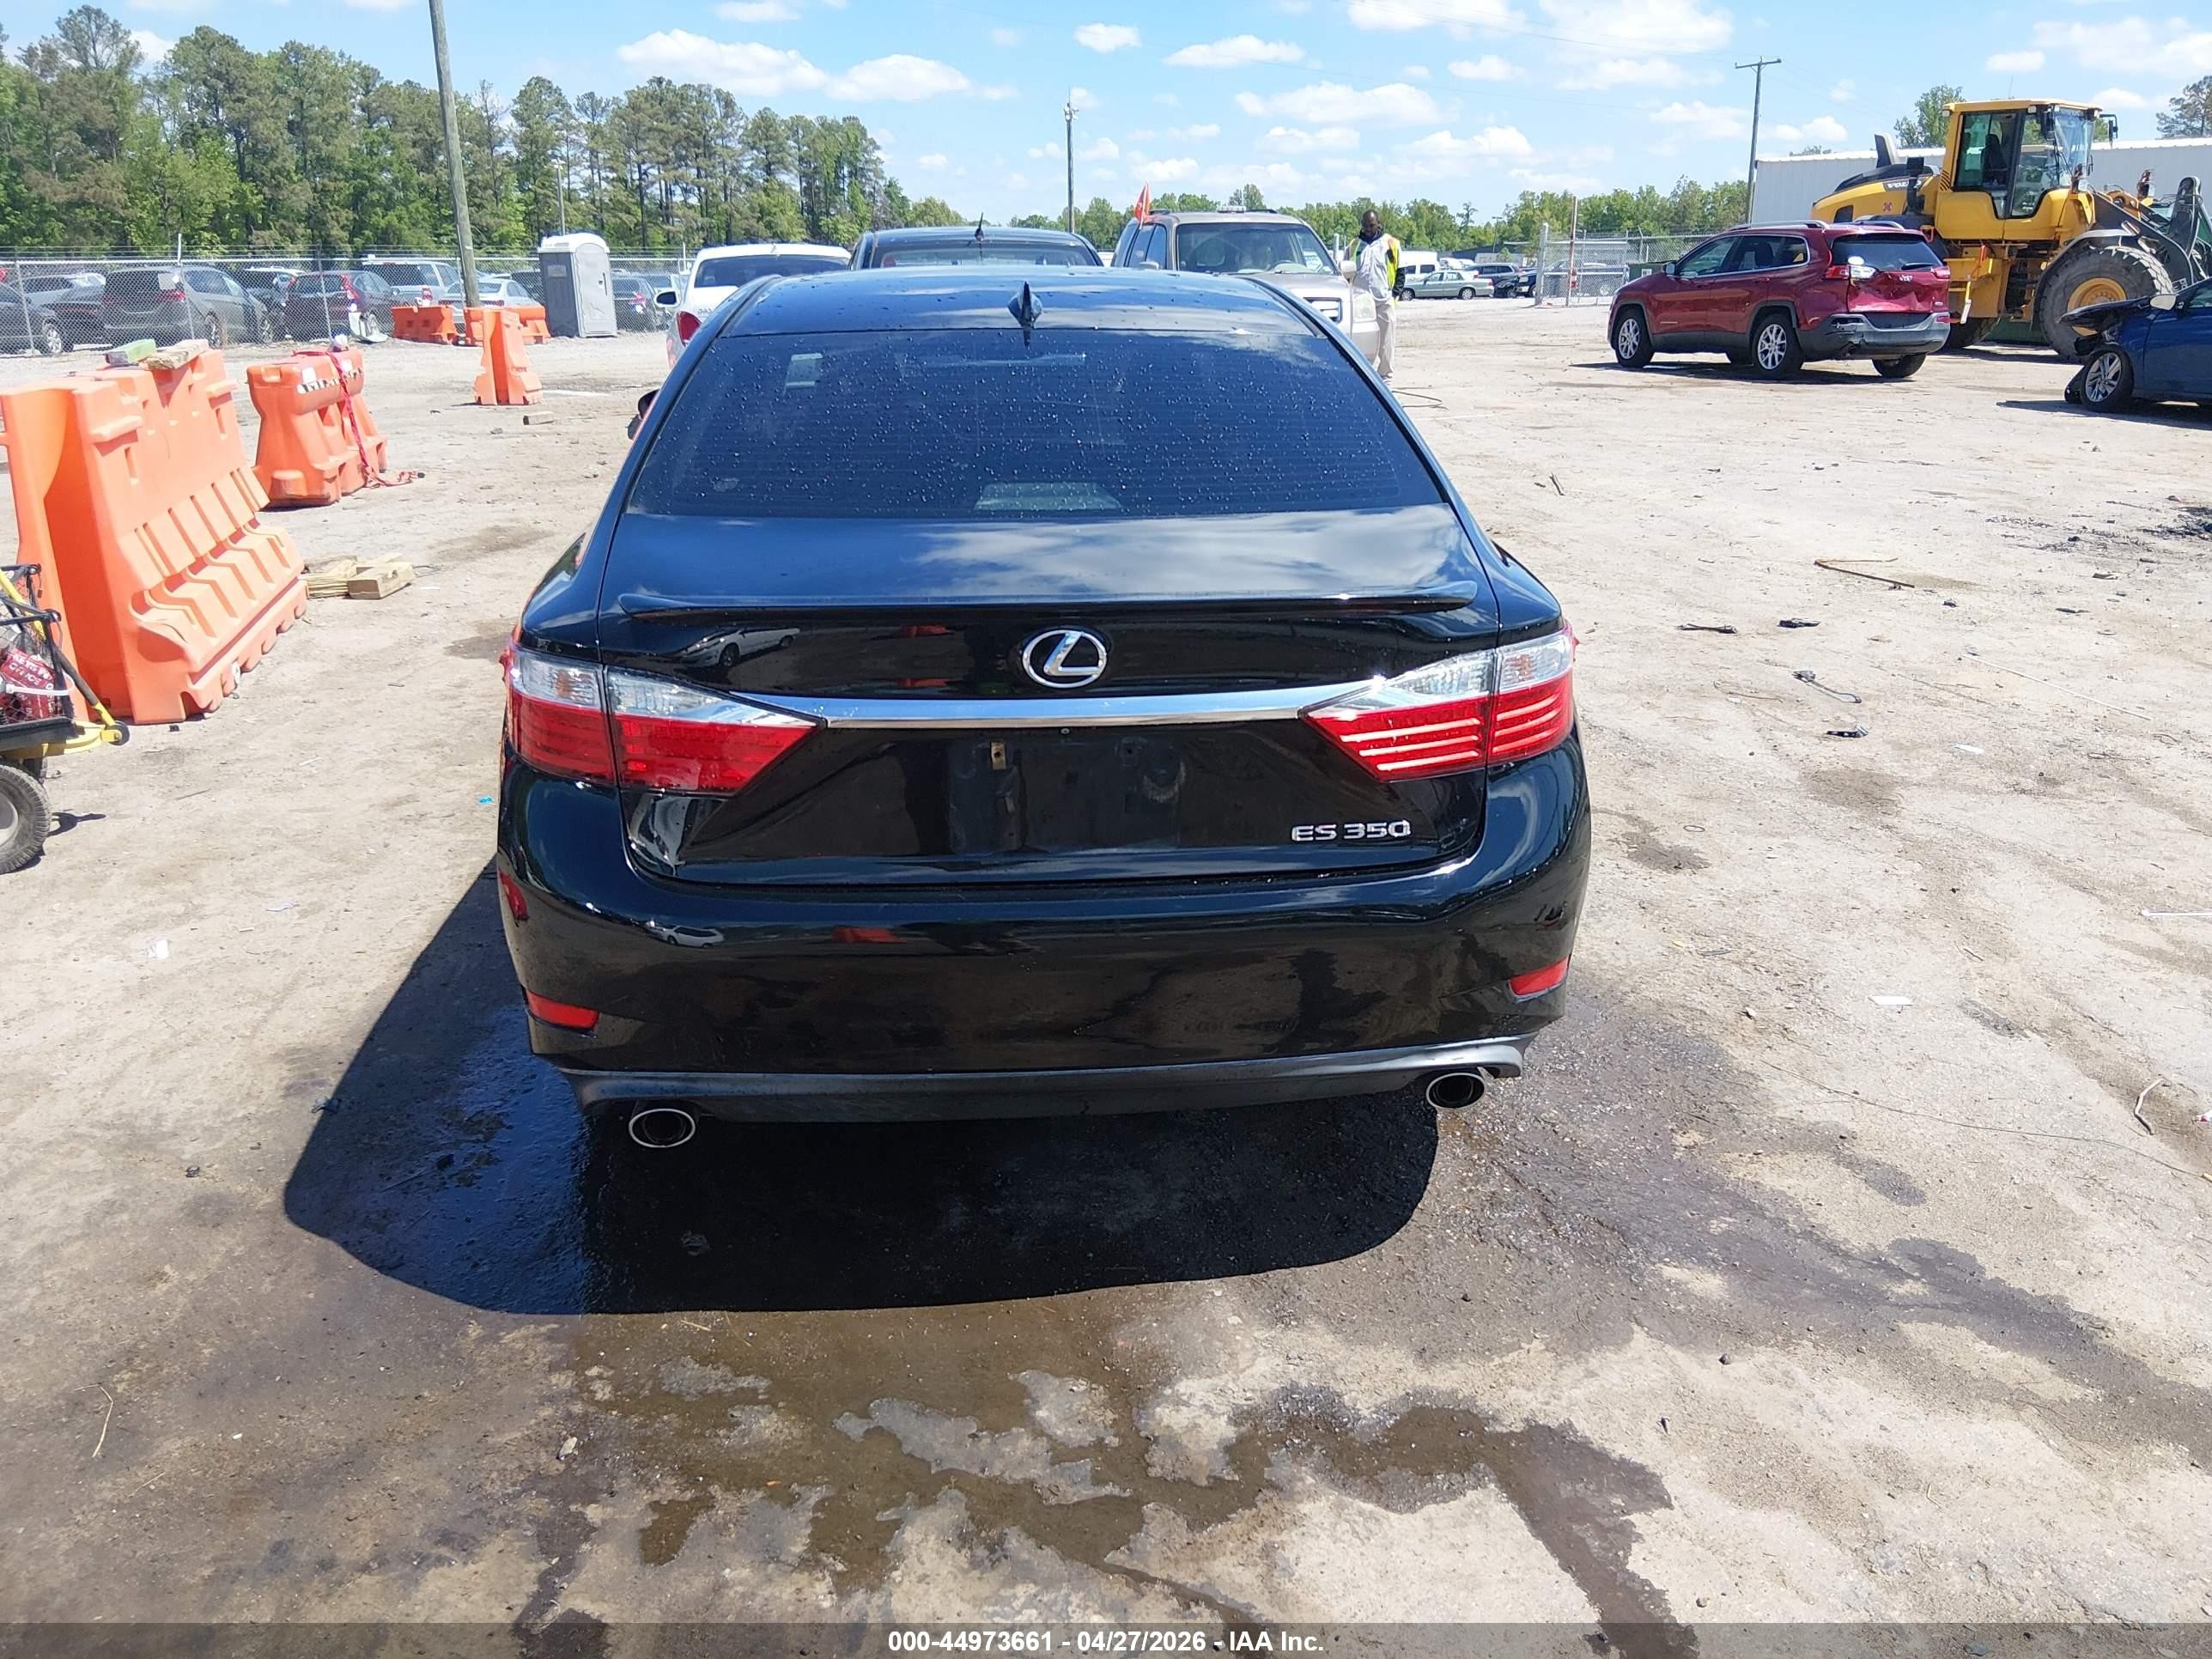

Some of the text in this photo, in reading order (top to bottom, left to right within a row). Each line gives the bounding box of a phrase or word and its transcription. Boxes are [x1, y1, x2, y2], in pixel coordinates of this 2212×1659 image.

[1887, 179, 1923, 189] VOLO
[1291, 818, 1412, 842] ES 350
